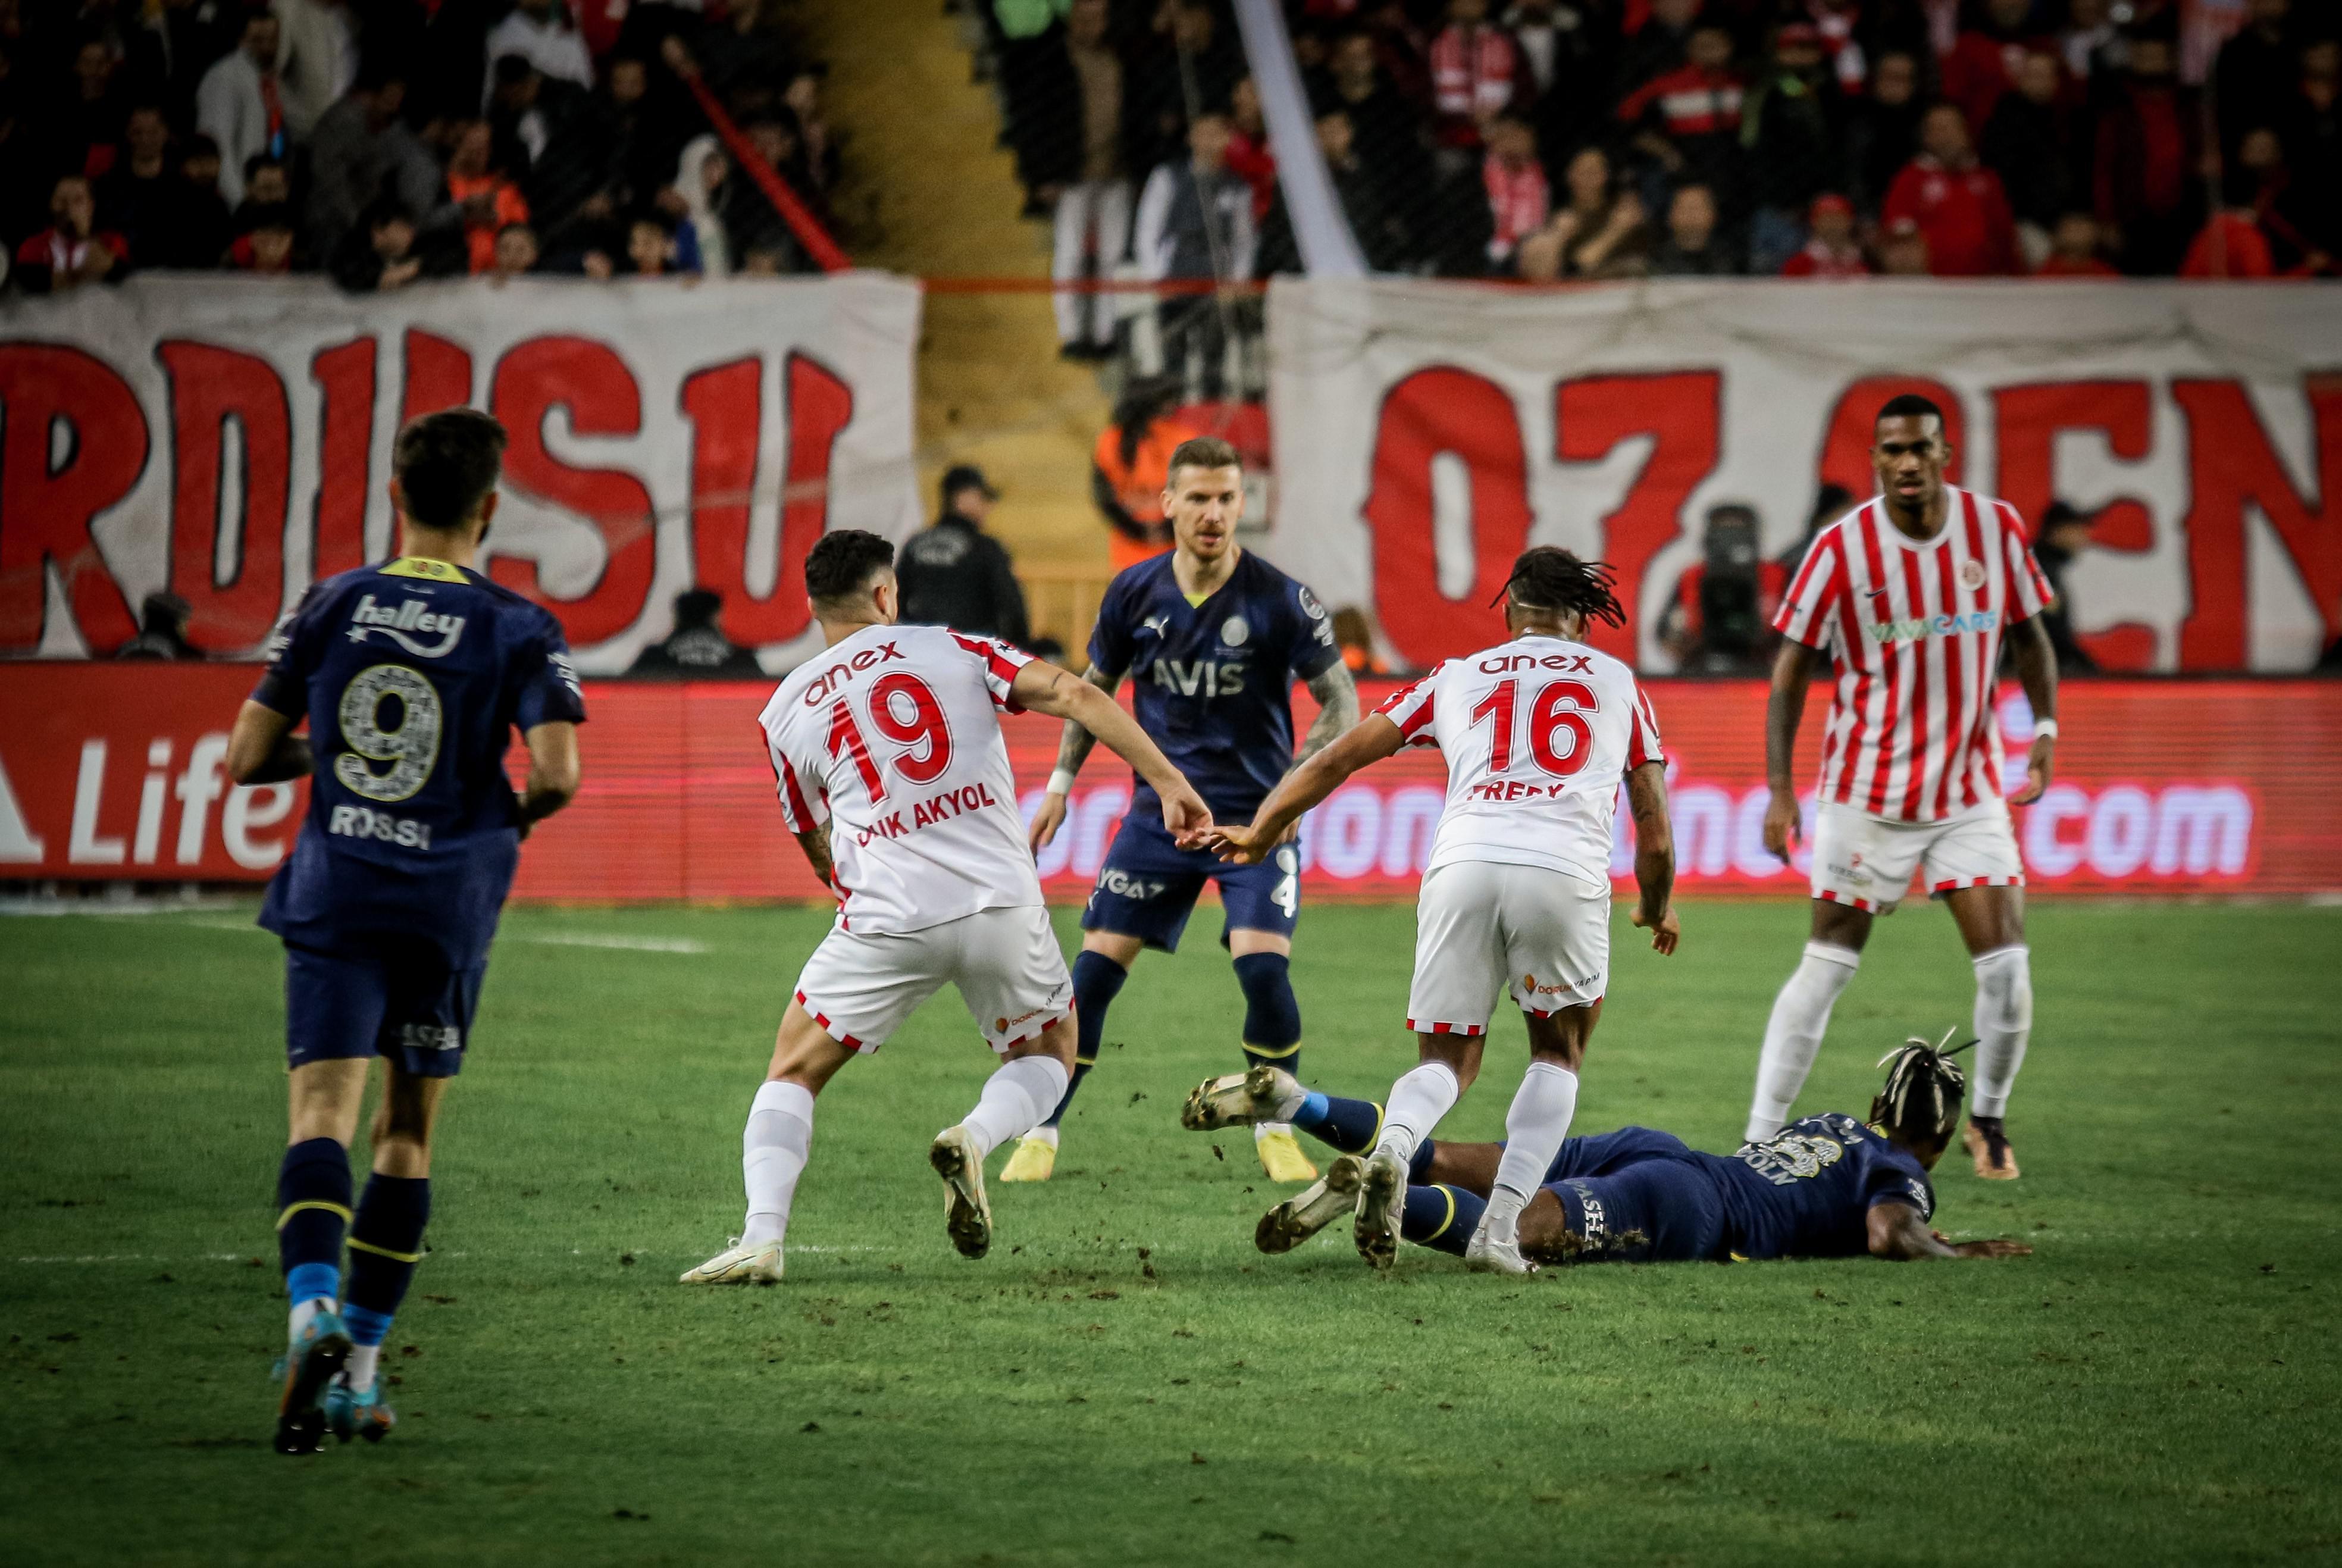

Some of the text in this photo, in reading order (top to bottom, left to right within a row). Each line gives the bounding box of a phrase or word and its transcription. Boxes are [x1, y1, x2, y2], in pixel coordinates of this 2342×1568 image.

[1359, 365, 1722, 670] 07
[351, 593, 467, 659] halley
[1867, 611, 1998, 643] VAVACARS
[804, 640, 907, 707] anex
[1153, 658, 1245, 698] AVIS
[1479, 655, 1595, 675] anex
[333, 663, 443, 802] 9
[823, 670, 955, 809] 19
[1469, 678, 1600, 780] 16
[68, 733, 296, 871] Life
[329, 805, 432, 850] ROSSI
[913, 782, 995, 830] AKYOL
[1270, 873, 1296, 918] 4
